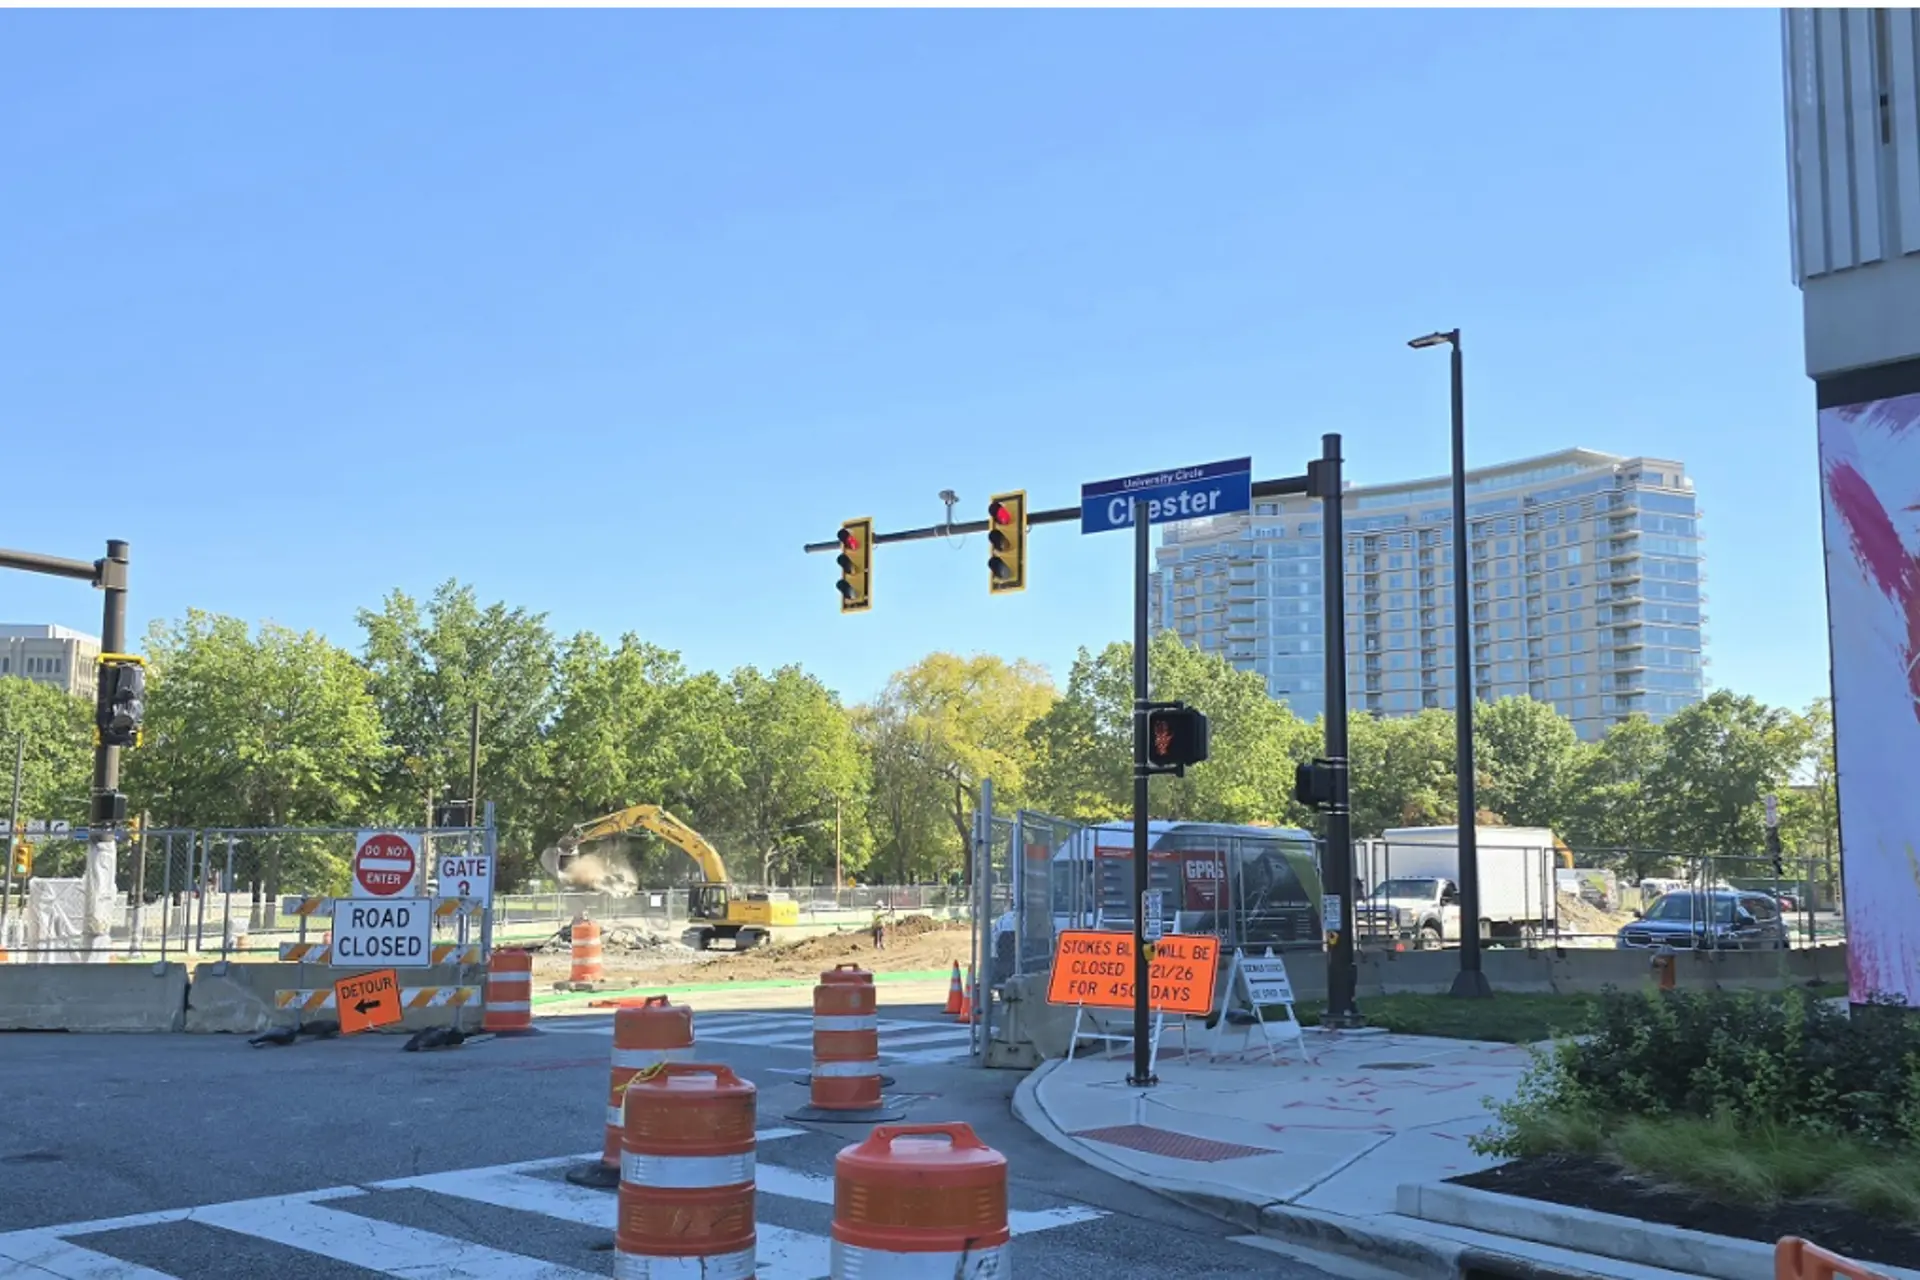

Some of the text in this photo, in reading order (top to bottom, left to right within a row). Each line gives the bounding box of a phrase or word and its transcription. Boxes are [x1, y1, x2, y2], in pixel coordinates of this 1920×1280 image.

[1123, 467, 1204, 488] University Circle
[365, 845, 408, 857] DO NOT
[366, 872, 401, 885] ENTER
[442, 859, 487, 878] GATE
[352, 908, 410, 929] ROAD
[338, 936, 422, 957] CLOSED
[1062, 940, 1112, 956] STOKES
[1156, 943, 1185, 958] WILL
[1192, 945, 1210, 960] BE
[1072, 961, 1125, 977] CLOSED
[341, 977, 393, 999] DETOUR
[1069, 980, 1097, 996] FOR
[1151, 985, 1191, 1001] DAYS
